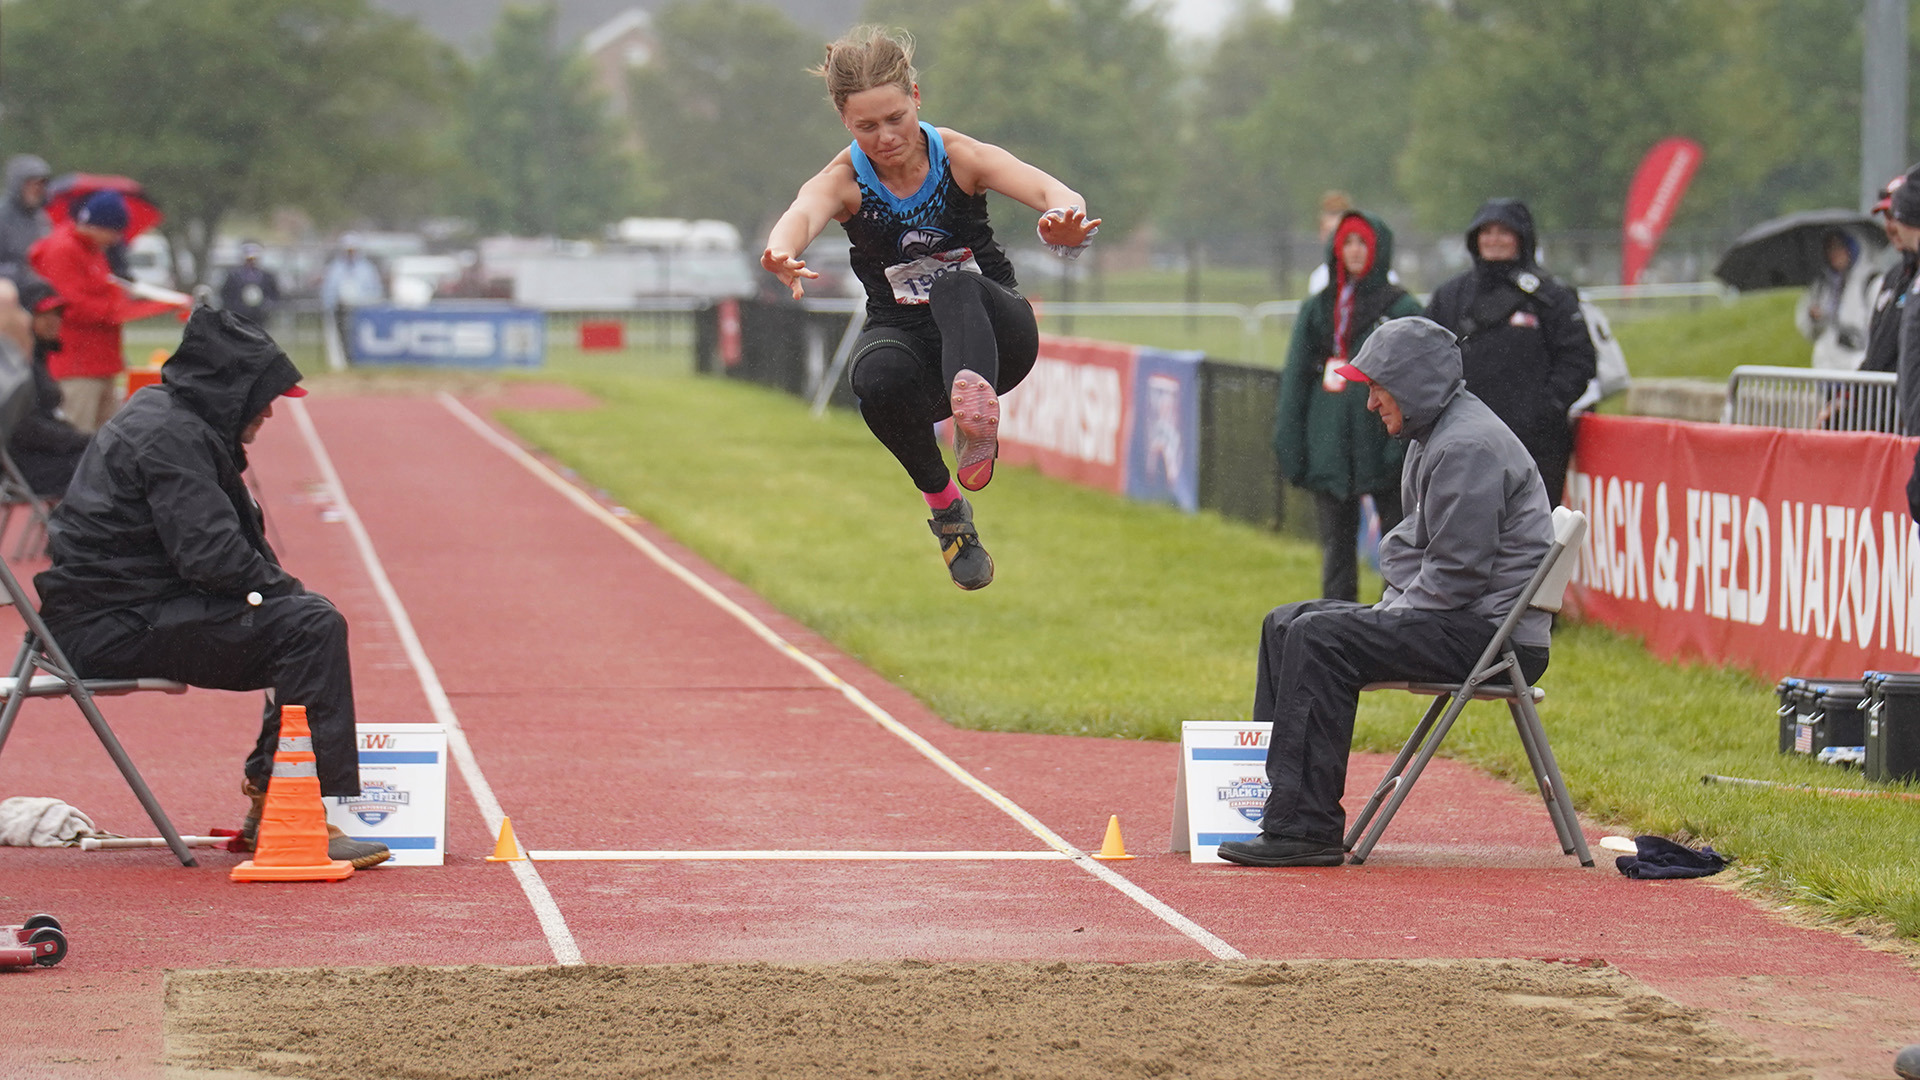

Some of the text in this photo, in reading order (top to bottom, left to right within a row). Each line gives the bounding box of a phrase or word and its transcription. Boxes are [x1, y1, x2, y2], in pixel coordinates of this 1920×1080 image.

[1653, 481, 1679, 611] &
[1684, 488, 1771, 626] FIELD
[360, 734, 396, 749] IWU
[1234, 731, 1269, 746] IWU
[362, 780, 385, 788] NAIA
[1218, 788, 1252, 800] TRACK
